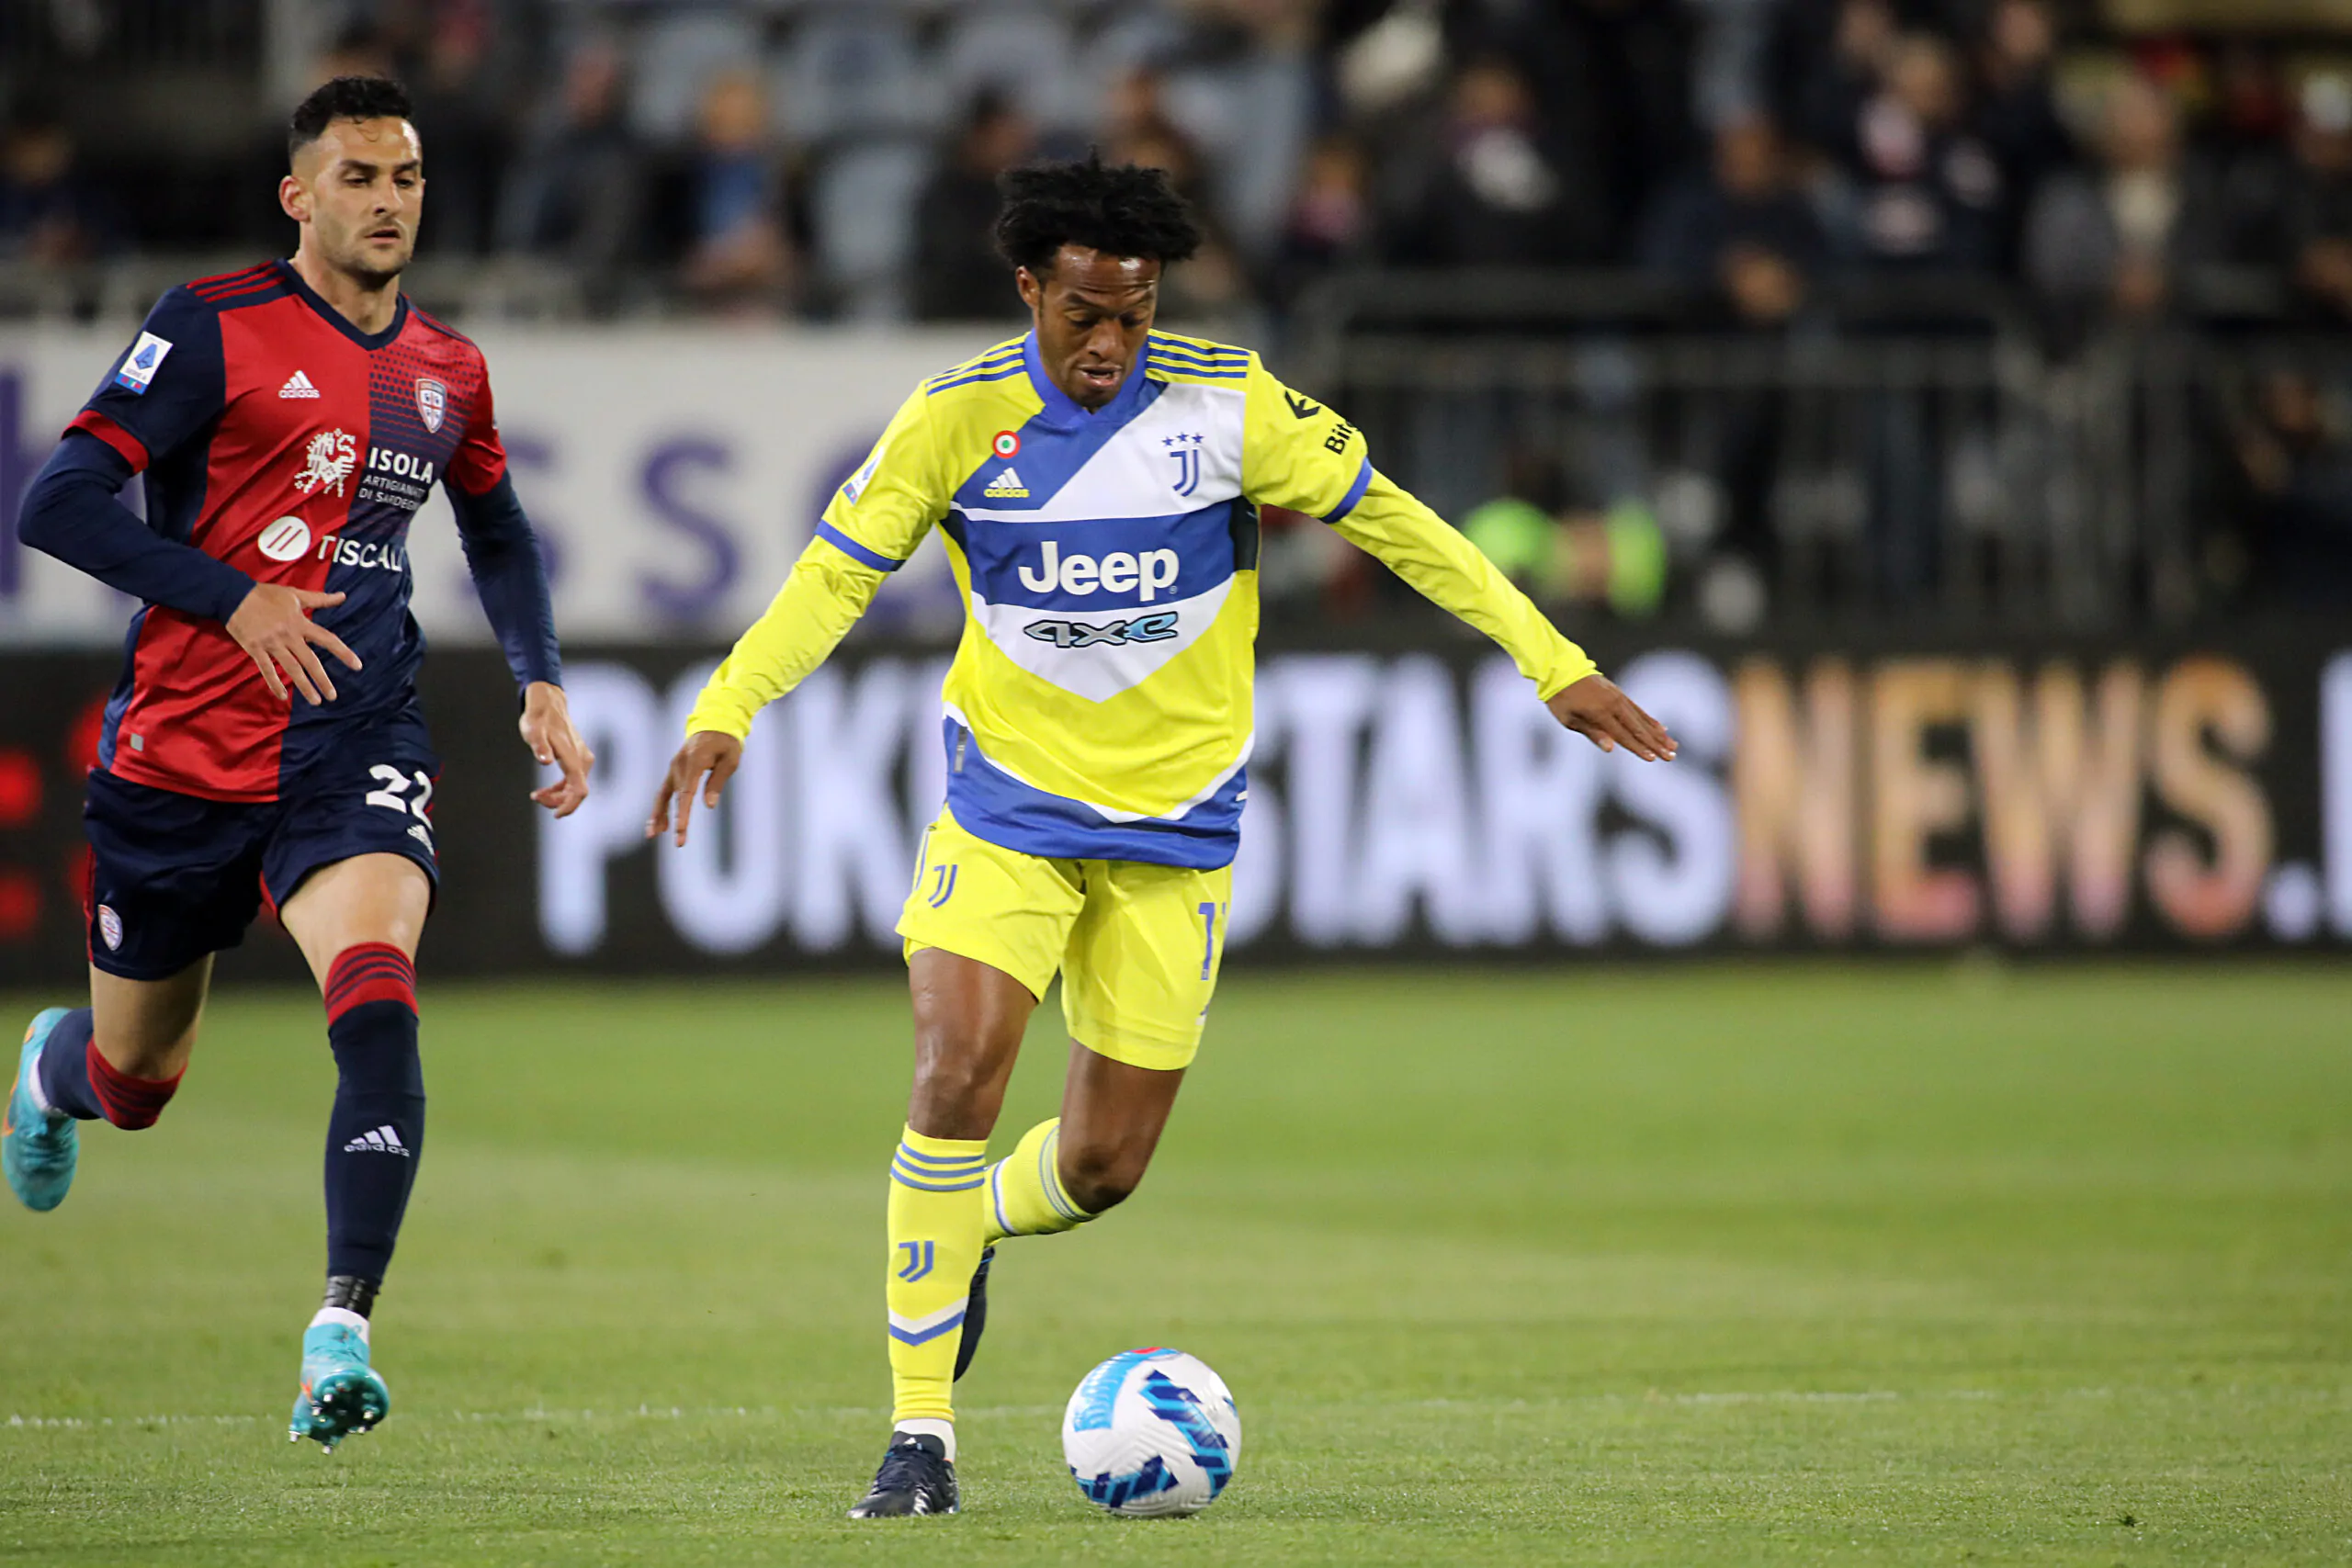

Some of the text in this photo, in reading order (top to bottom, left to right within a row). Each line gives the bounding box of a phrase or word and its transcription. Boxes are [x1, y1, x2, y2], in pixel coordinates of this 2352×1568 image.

[278, 389, 321, 399] adidas
[1324, 421, 1354, 455] Bit
[368, 447, 434, 484] ISOLA
[359, 488, 373, 500] DI
[363, 475, 425, 499] ARTIGIANAT
[984, 487, 1030, 498] adidas
[1018, 540, 1180, 602] Jeep
[1198, 901, 1227, 980] 1
[344, 1143, 410, 1157] adidas
